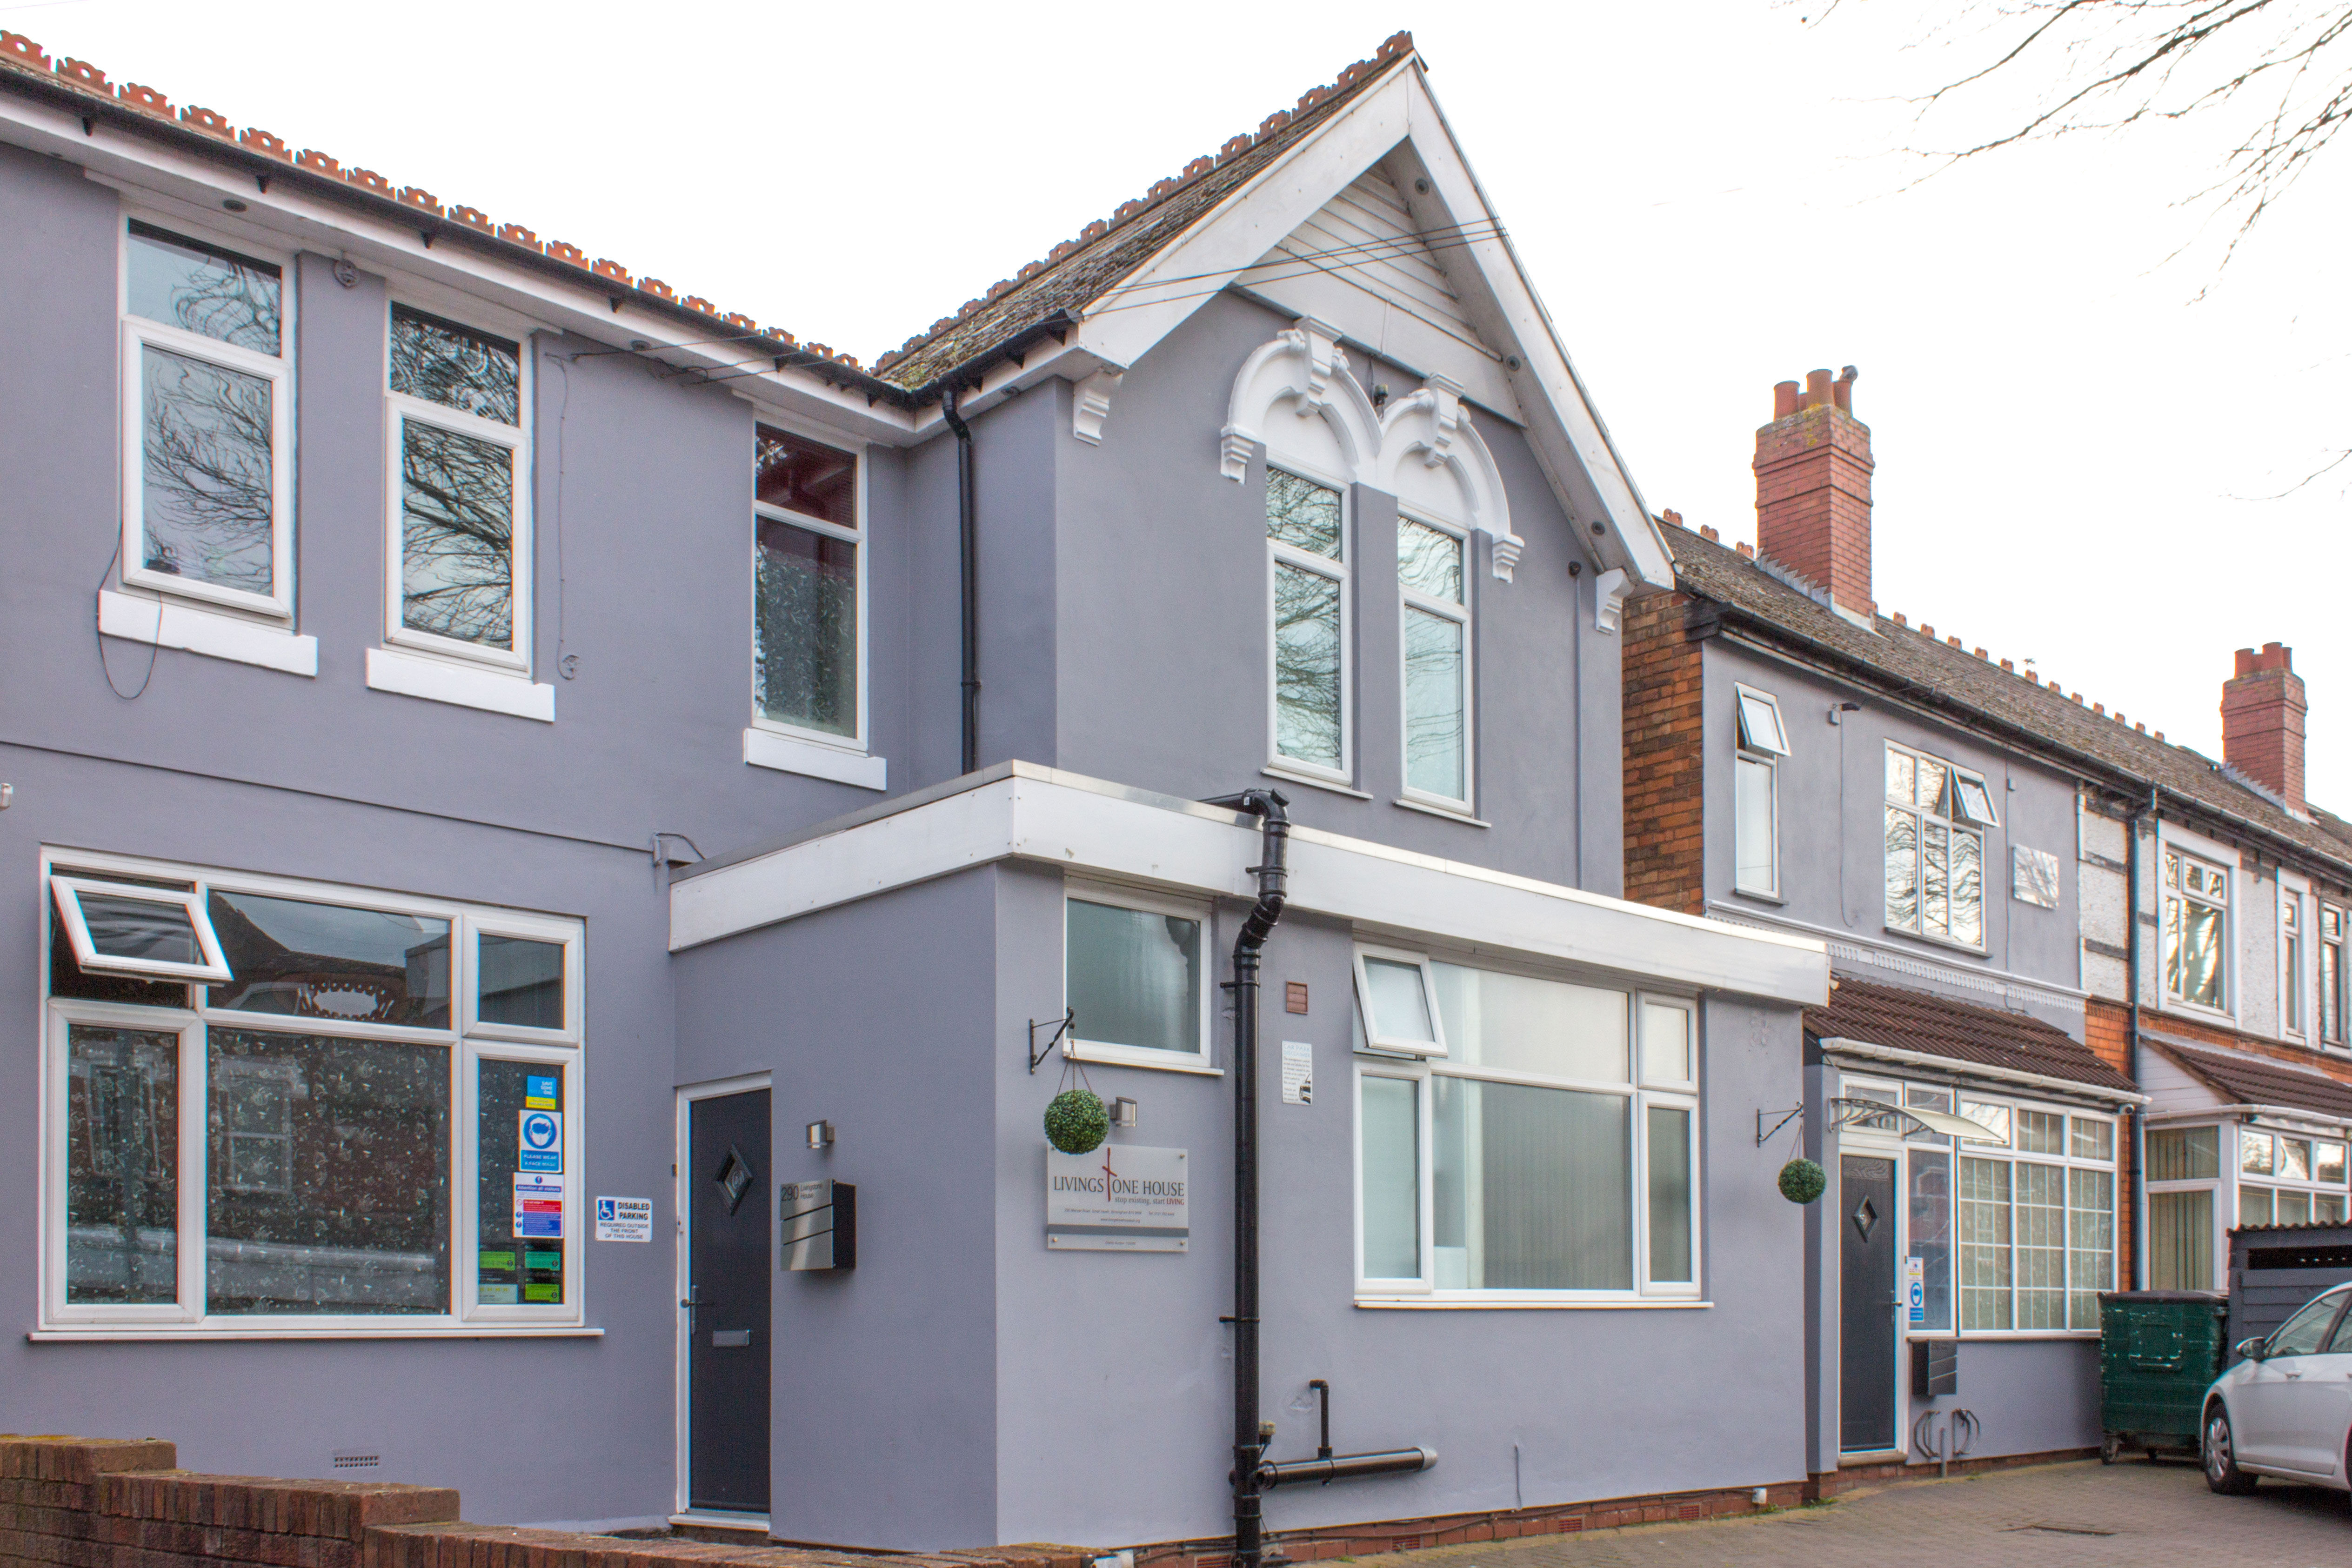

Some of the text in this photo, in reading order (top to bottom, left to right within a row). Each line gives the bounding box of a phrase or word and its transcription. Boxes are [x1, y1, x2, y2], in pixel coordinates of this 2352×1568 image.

[782, 1185, 799, 1201] 290
[1143, 1181, 1184, 1196] HOUSE
[618, 1202, 650, 1210] DISABLED
[619, 1212, 648, 1220] PARKING
